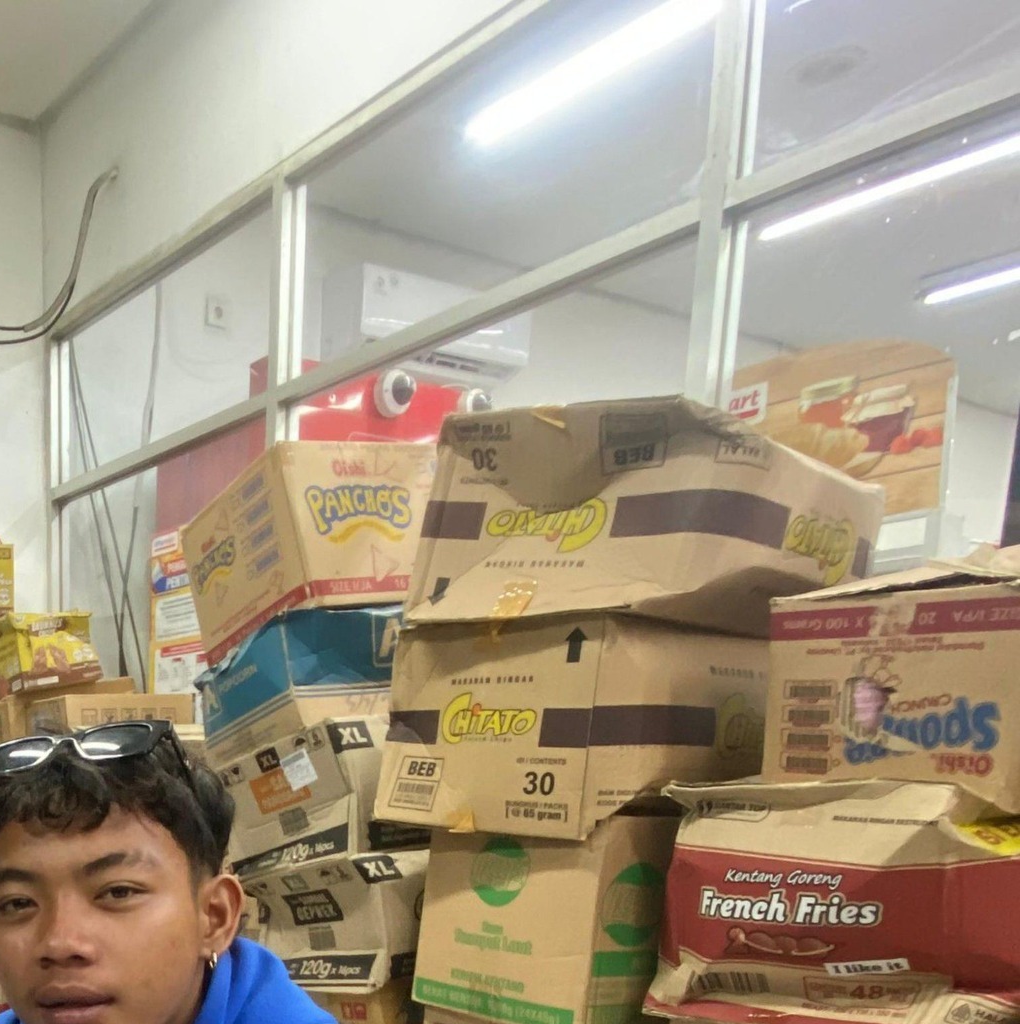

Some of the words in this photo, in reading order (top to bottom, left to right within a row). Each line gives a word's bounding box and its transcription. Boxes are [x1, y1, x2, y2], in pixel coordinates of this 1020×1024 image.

[338, 726, 368, 745] XL
[408, 761, 436, 777] BEB
[522, 771, 555, 796] 30
[363, 860, 395, 878] XL
[724, 869, 783, 888] Kentang
[787, 870, 842, 890] Goreng
[699, 888, 787, 923] French
[794, 893, 883, 926] Fries
[300, 959, 332, 979] 120g
[832, 964, 842, 974] I
[844, 963, 883, 974] like
[886, 961, 904, 971] it
[849, 984, 884, 1000] 48
